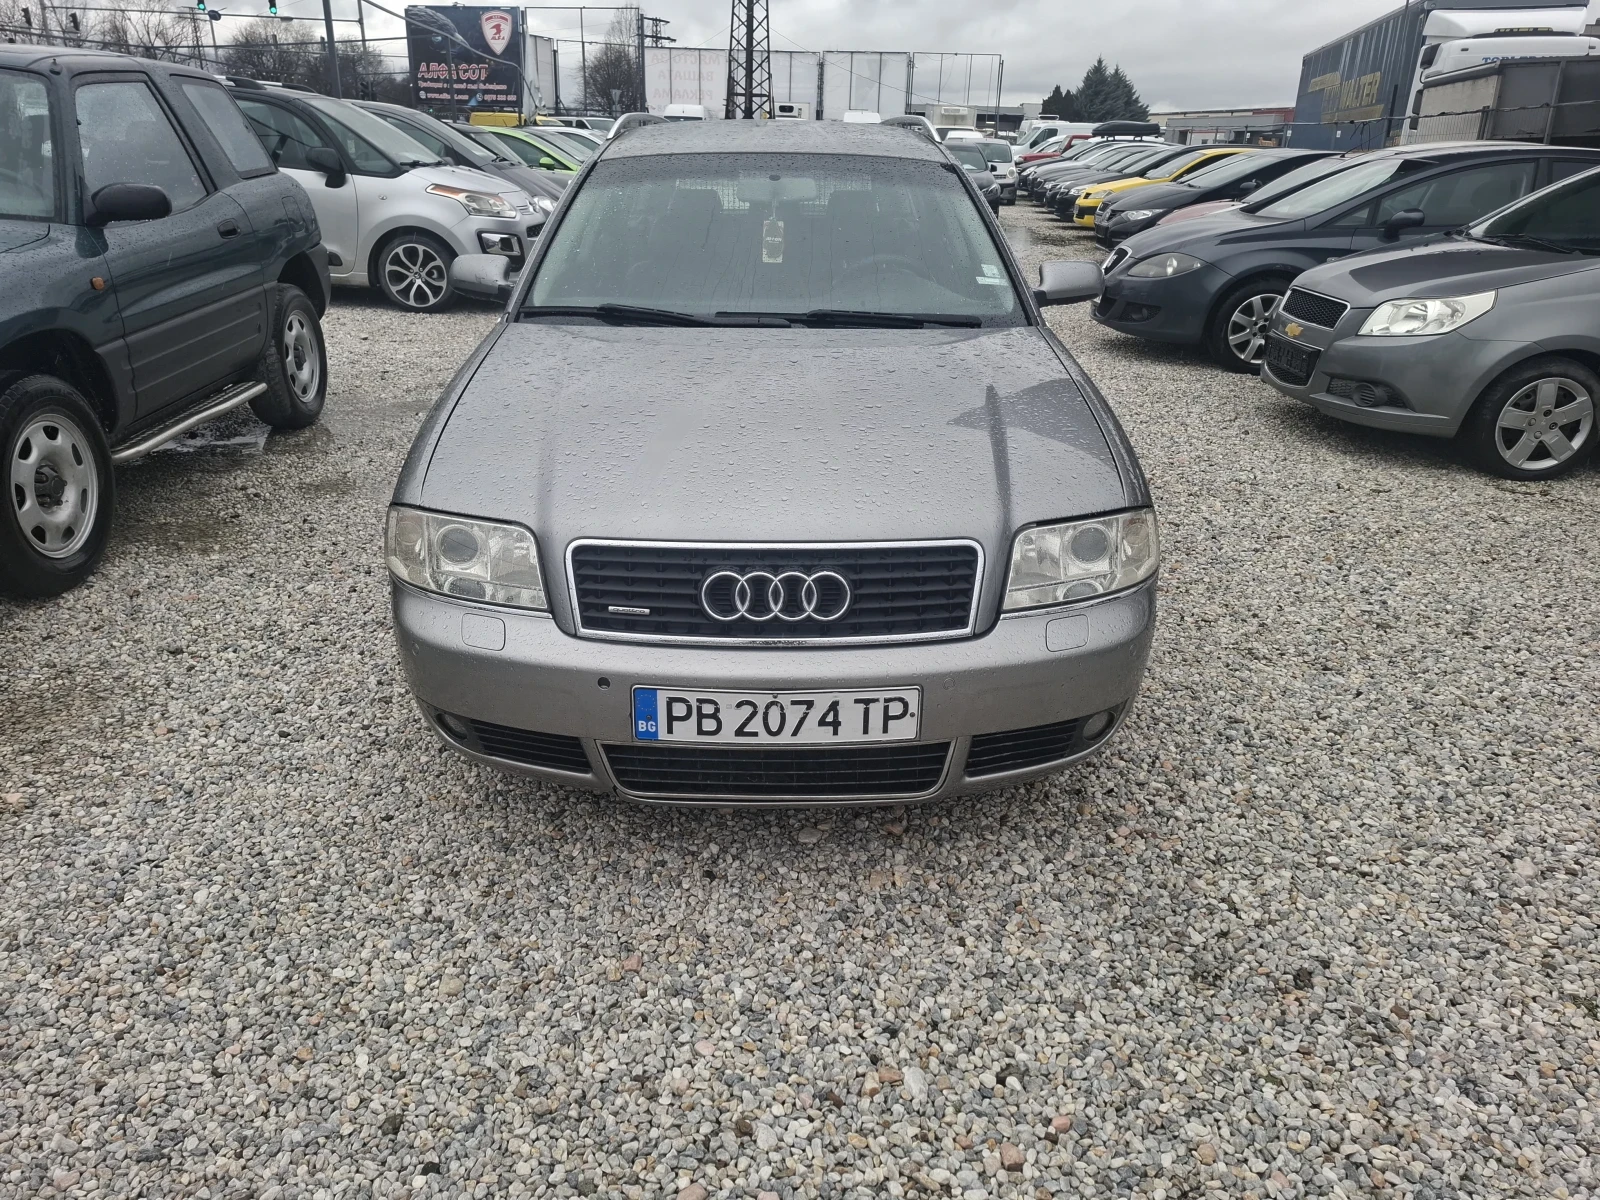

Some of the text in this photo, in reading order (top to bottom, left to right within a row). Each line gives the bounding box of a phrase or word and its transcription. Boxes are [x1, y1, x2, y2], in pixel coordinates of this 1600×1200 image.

[1340, 71, 1381, 110] WALTER
[638, 720, 657, 732] BG
[666, 696, 909, 737] PB 2074 TP
